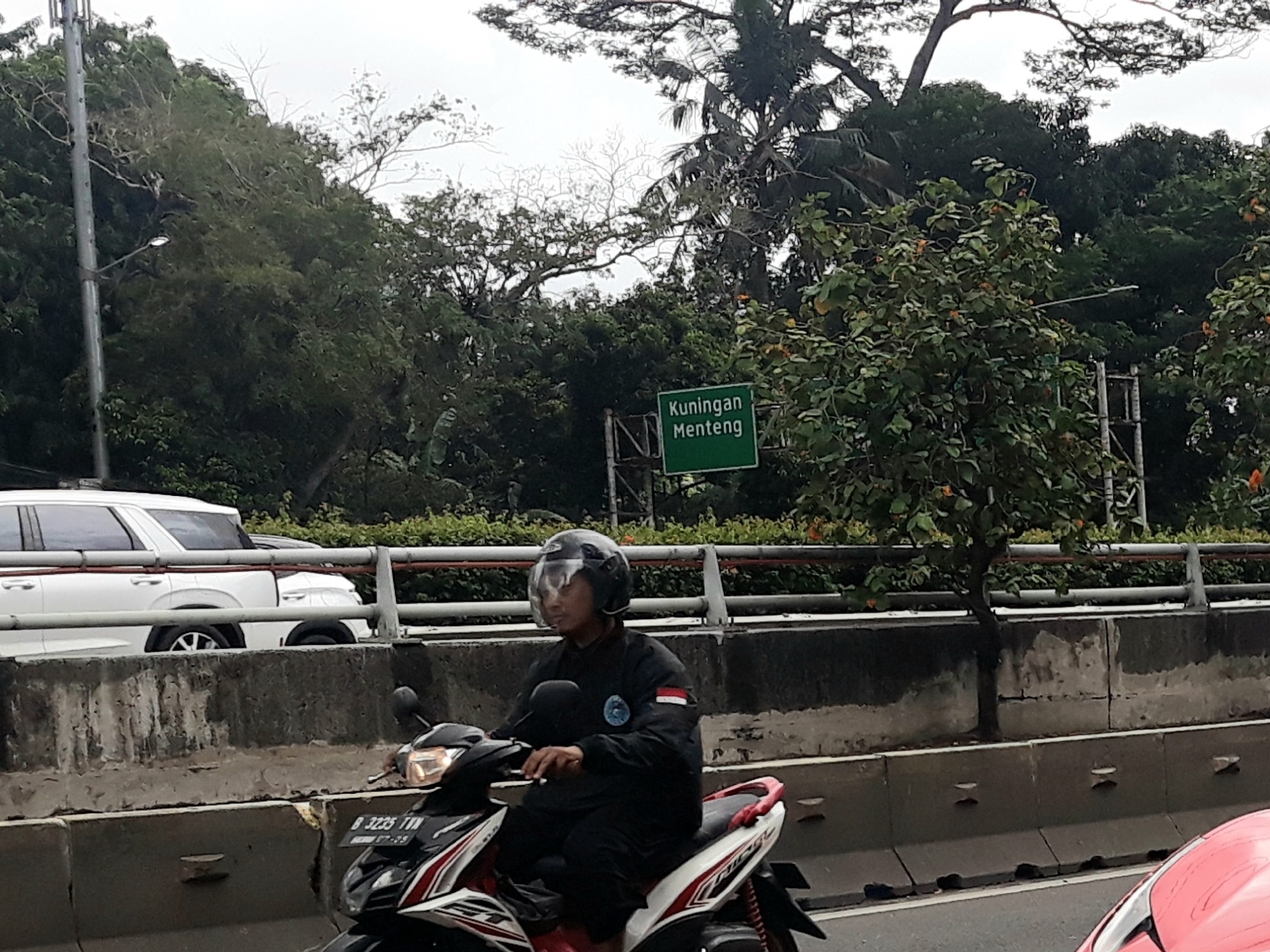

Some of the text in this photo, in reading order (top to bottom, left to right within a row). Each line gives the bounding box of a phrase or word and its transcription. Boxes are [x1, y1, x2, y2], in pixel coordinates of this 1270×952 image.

[668, 396, 743, 417] Kuningan
[673, 419, 743, 439] Menteng
[350, 816, 364, 831] B
